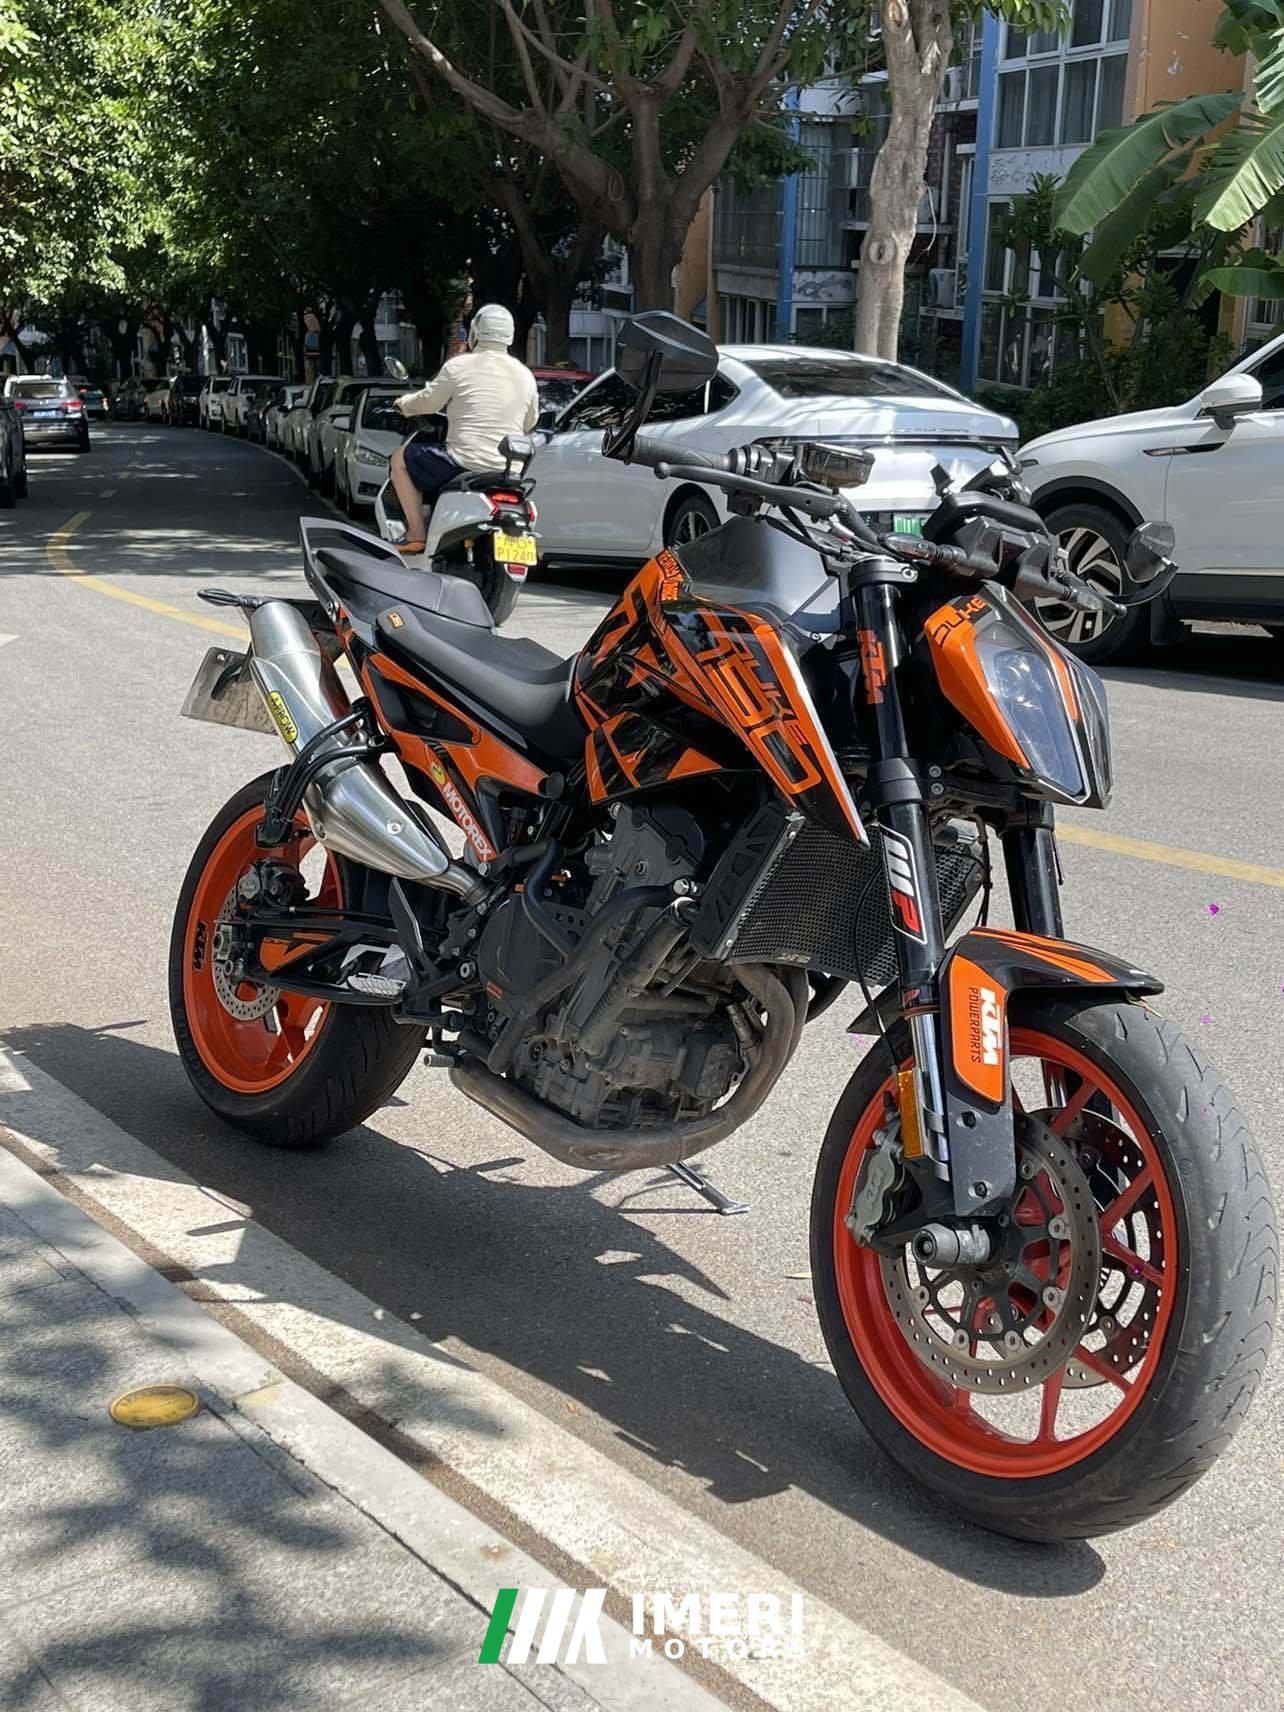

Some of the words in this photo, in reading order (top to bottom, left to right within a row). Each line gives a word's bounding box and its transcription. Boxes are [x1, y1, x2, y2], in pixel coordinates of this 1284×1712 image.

[932, 596, 987, 648] DUKE
[695, 606, 823, 796] 790
[858, 629, 888, 705] KTM
[271, 694, 297, 735] ARROW
[443, 782, 492, 862] MOTOREX
[968, 986, 981, 1064] POWERPARTS
[980, 986, 1002, 1066] KTM
